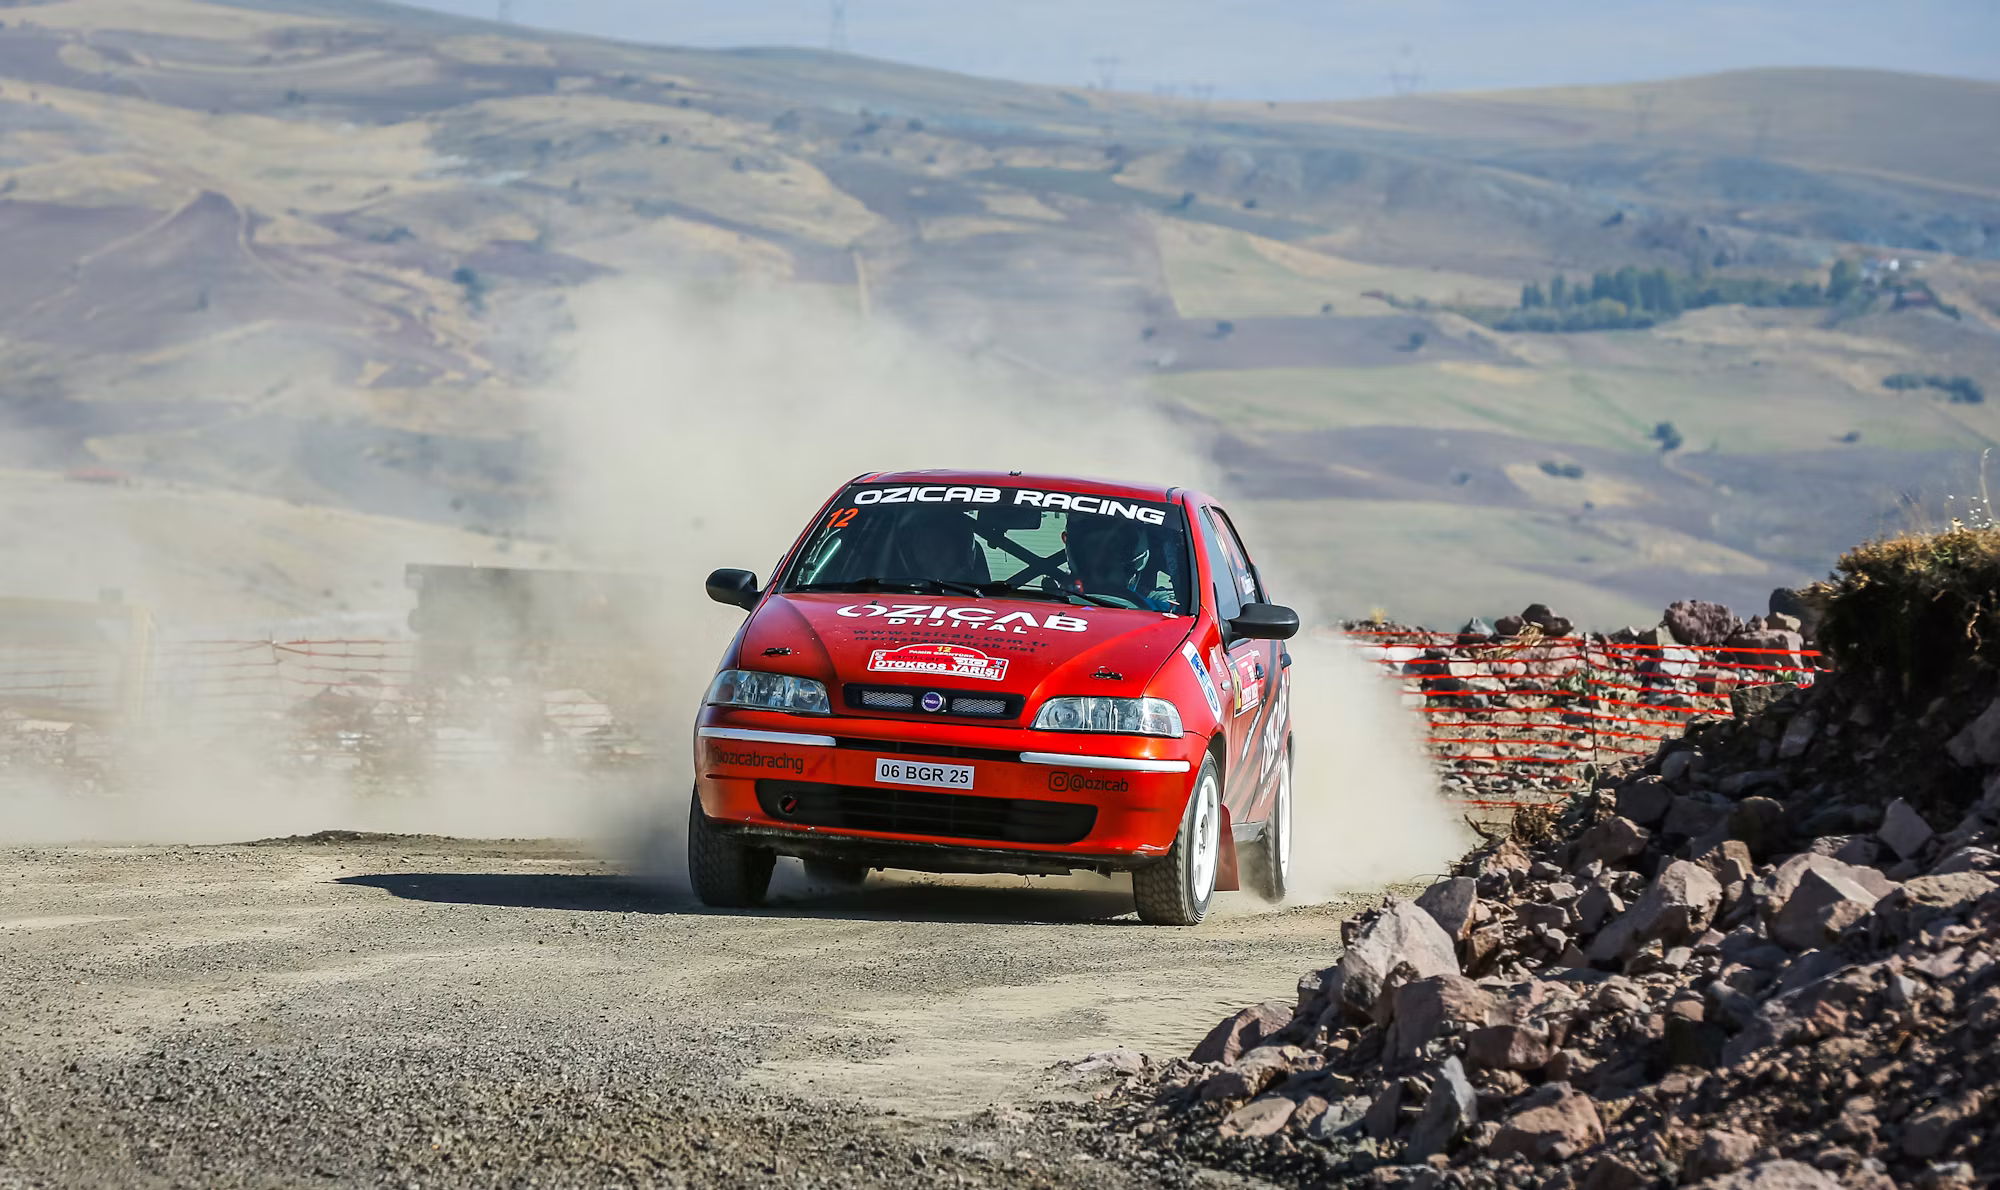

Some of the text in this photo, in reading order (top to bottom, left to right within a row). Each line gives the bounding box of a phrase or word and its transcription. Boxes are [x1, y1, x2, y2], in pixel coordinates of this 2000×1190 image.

[854, 486, 1166, 526] OZICAB RACING
[826, 507, 859, 529] 12
[836, 603, 1089, 633] OZICAB
[853, 630, 1050, 648] www.ozicab.com.tr
[875, 660, 947, 671] OTOKROS
[881, 764, 969, 784] 06 BGR 25
[1069, 773, 1129, 793] @ozicab
